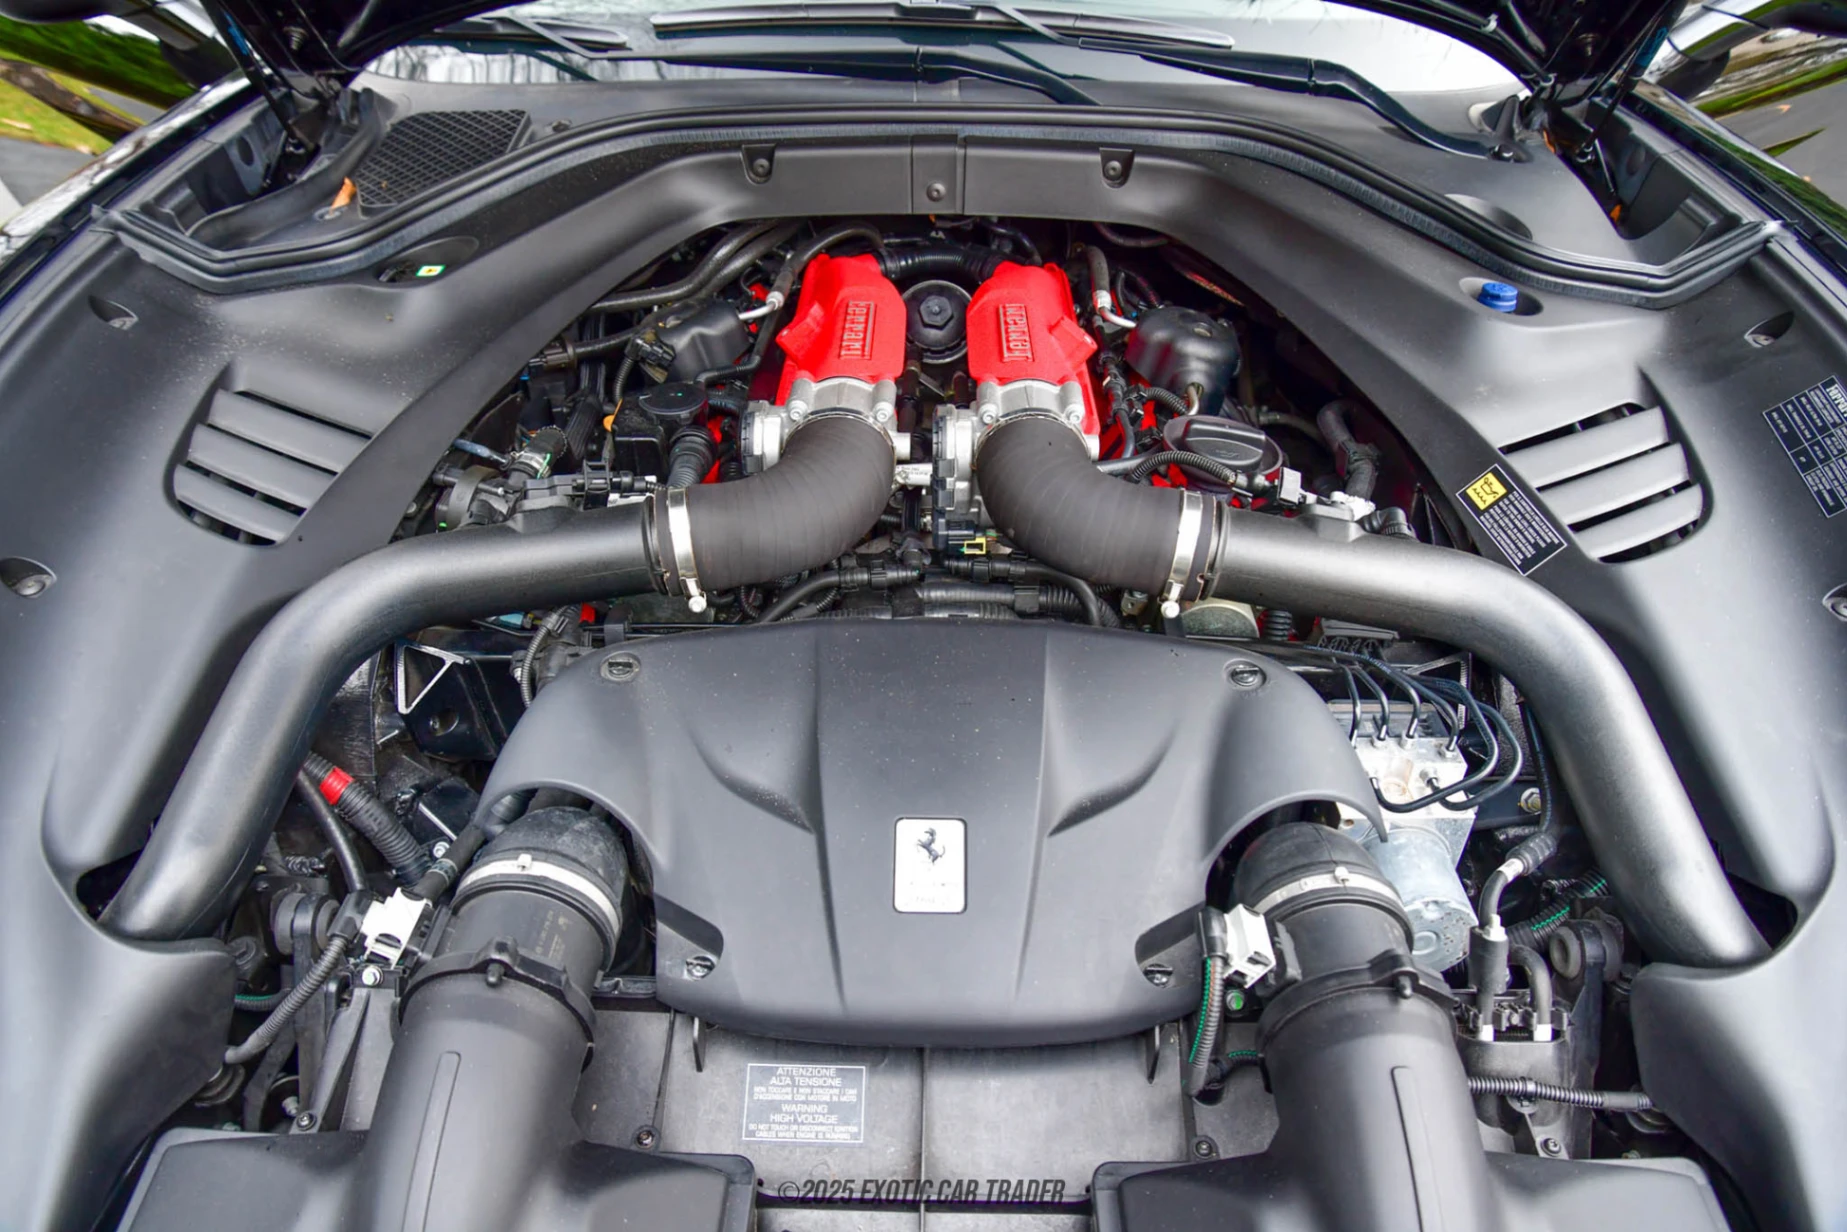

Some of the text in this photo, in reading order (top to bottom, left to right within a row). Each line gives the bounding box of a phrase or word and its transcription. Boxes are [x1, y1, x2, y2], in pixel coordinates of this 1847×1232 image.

[841, 301, 873, 360] Ferrari
[1000, 303, 1033, 361] Ferrari
[776, 1067, 837, 1077] ATTENZIONE
[770, 1076, 842, 1087] ALTA TENSIONE
[781, 1103, 828, 1113] WARNING
[770, 1112, 838, 1124] HIGH VOLTAGE
